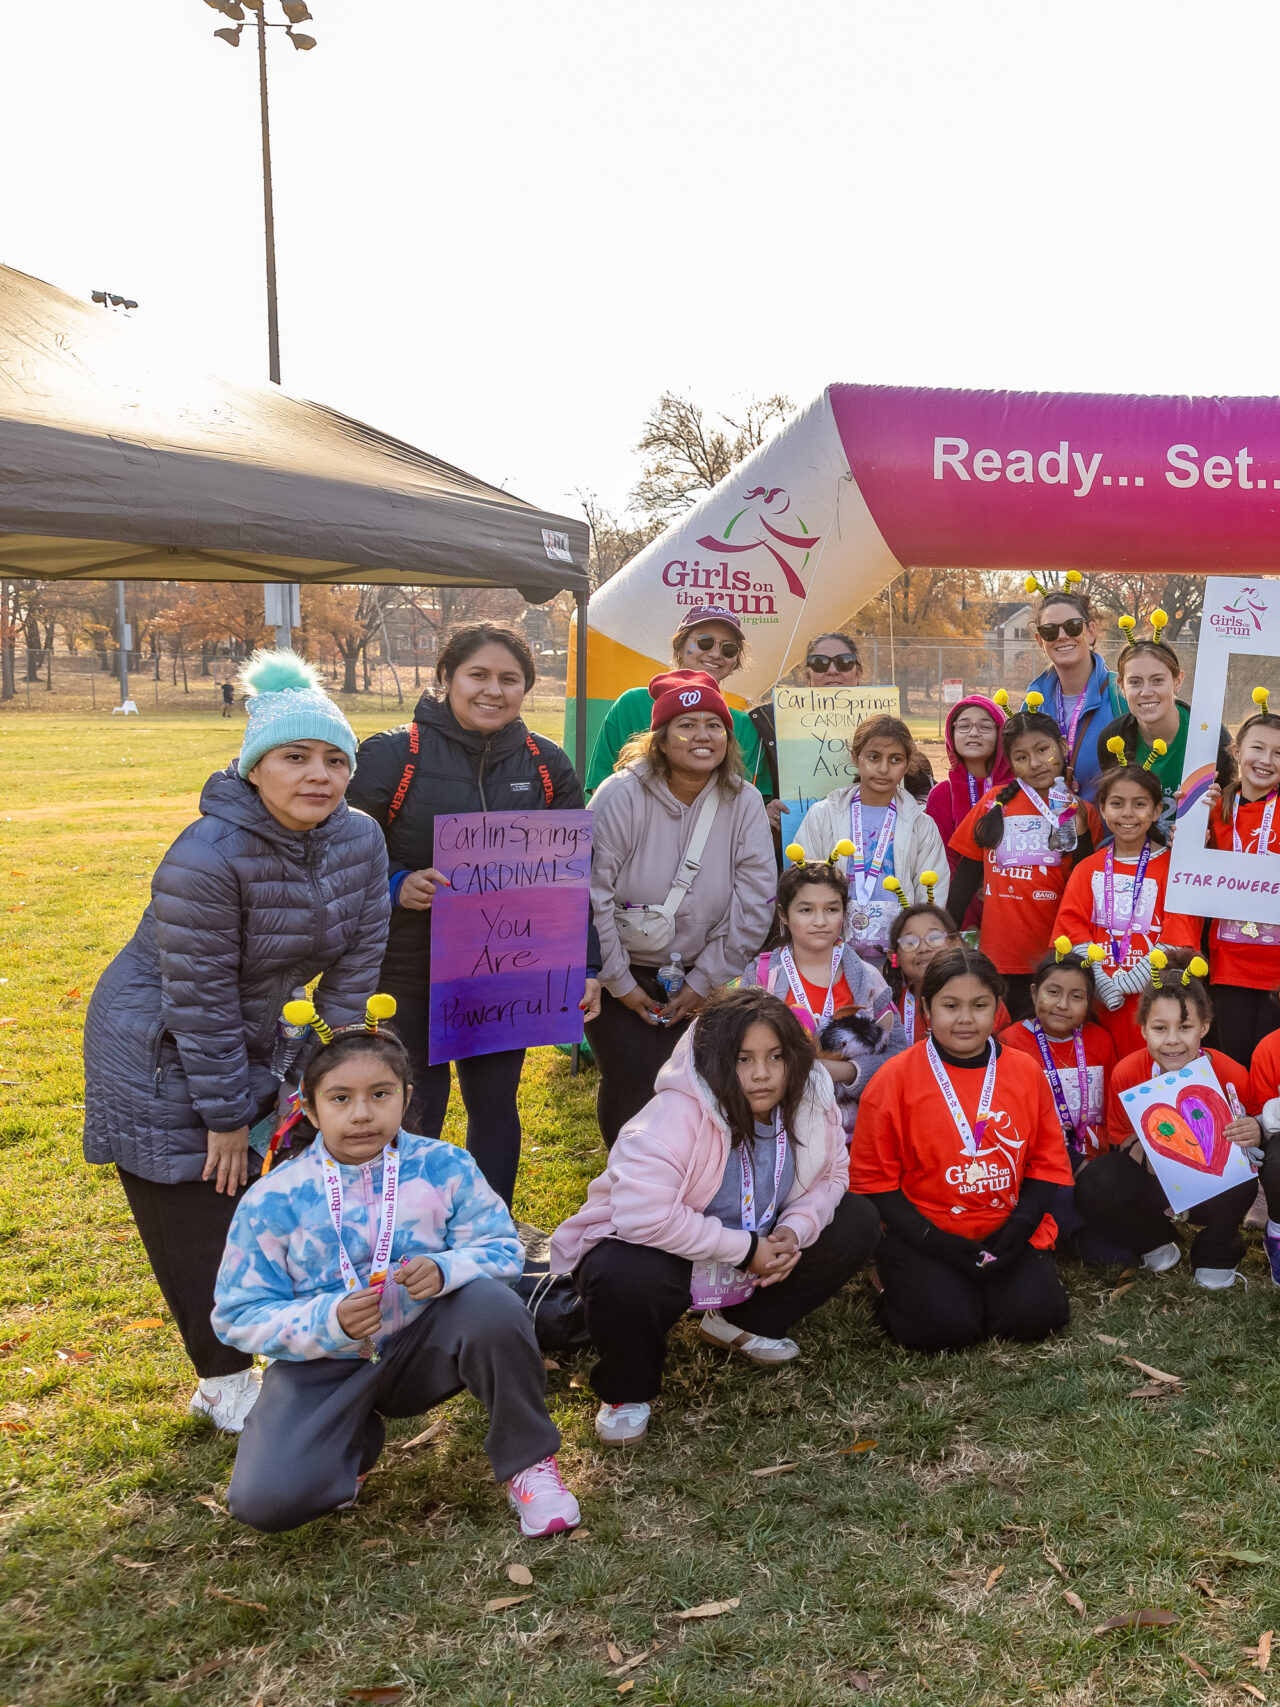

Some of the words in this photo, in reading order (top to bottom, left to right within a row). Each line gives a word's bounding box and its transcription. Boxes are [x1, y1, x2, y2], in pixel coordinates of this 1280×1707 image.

[933, 437, 1144, 497] Ready...
[662, 560, 751, 592] Girls
[753, 582, 774, 592] on
[676, 591, 703, 605] the
[705, 591, 778, 614] run
[1210, 614, 1243, 627] Girls
[1225, 626, 1251, 636] run
[777, 690, 835, 712] Carlin
[834, 689, 898, 716] Springs
[800, 712, 869, 728] CARDINA
[390, 764, 416, 811] UNDER
[883, 817, 893, 830] Run
[1028, 820, 1042, 830] 25
[1262, 812, 1272, 832] Girls
[438, 816, 505, 851] Carlin
[509, 816, 591, 857] Springs
[854, 831, 862, 846] Run
[450, 857, 584, 895] CARDINALS
[1172, 872, 1213, 887] STAR
[868, 907, 883, 918] 25
[481, 904, 531, 943] You
[471, 945, 540, 976] Are
[783, 955, 795, 975] Girls
[438, 965, 571, 1037] Powerful!
[905, 1018, 913, 1034] Run
[1037, 1033, 1048, 1053] Girls
[1047, 1069, 1058, 1086] Run
[927, 1044, 937, 1068] Girls
[942, 1081, 953, 1100] Run
[981, 1086, 992, 1107] Girls
[999, 1167, 1010, 1176] on
[384, 1177, 396, 1202] Run
[959, 1182, 977, 1195] the
[976, 1174, 1011, 1194] run
[331, 1187, 341, 1212] Run
[386, 1203, 394, 1220] the
[387, 1219, 394, 1231] on
[376, 1231, 391, 1262] Girls
